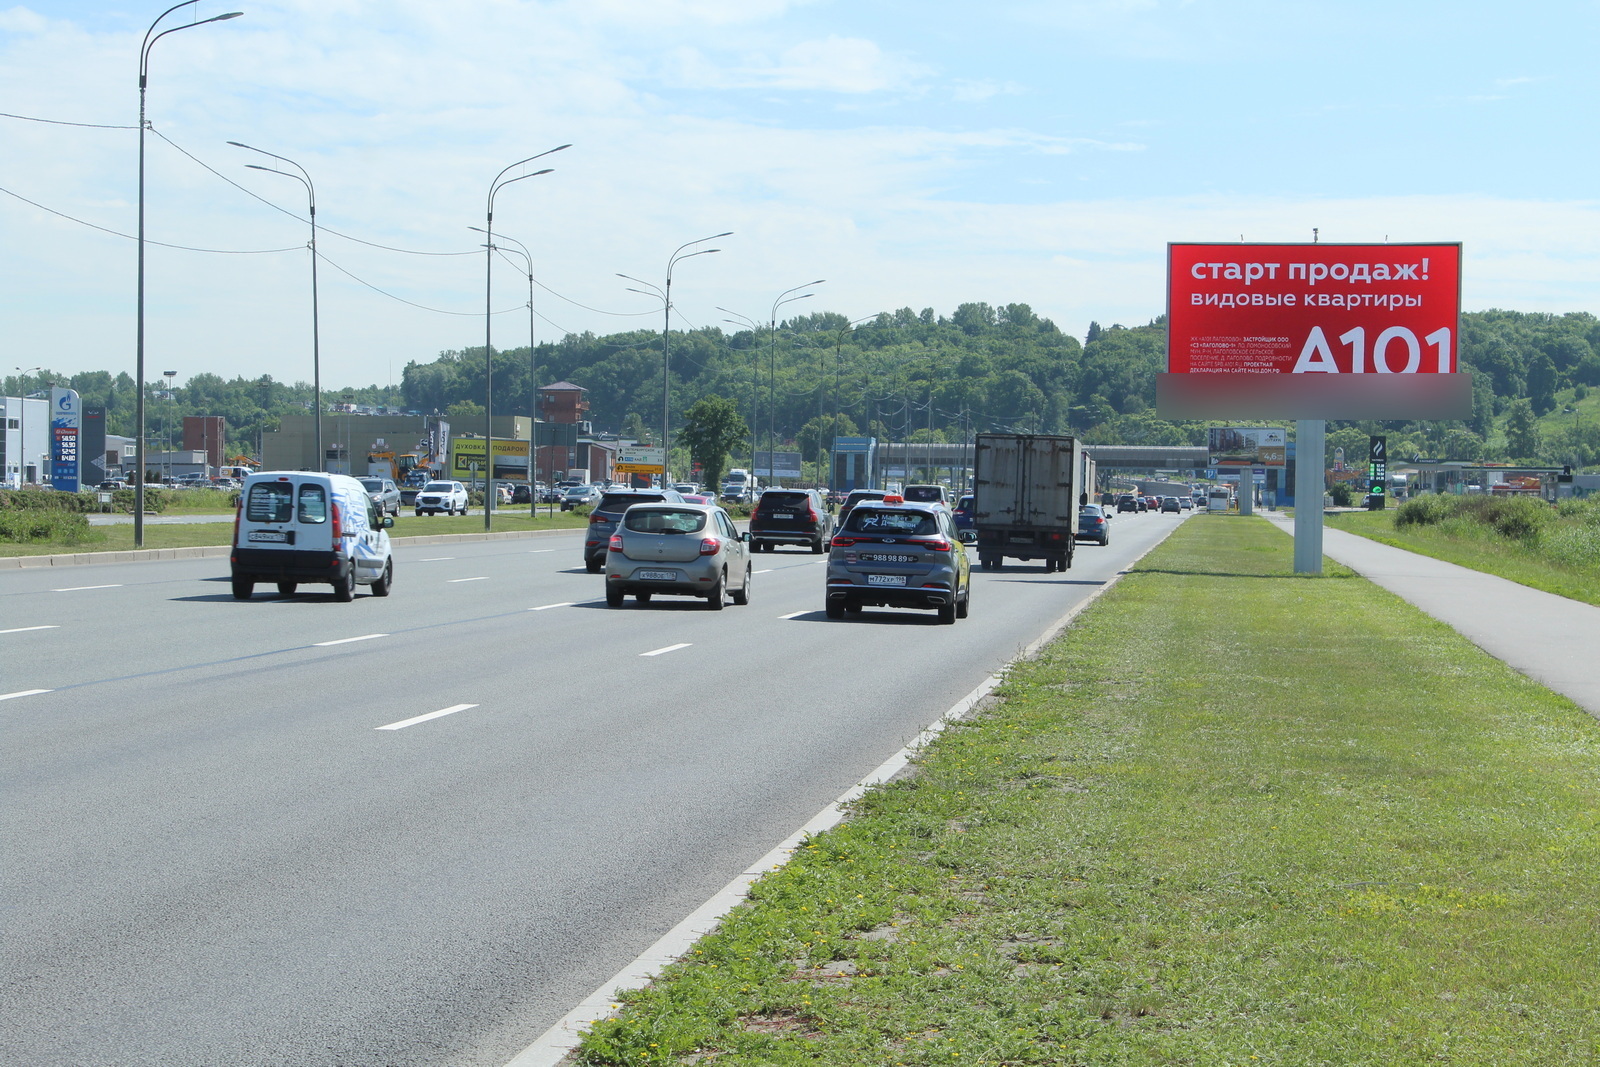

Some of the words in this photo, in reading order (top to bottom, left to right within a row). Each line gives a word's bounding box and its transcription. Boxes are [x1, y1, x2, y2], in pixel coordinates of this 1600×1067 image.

[1190, 262, 1280, 285] старт
[1288, 258, 1430, 286] продаж!
[1190, 293, 1297, 309] видовые
[1304, 293, 1422, 311] квартиры
